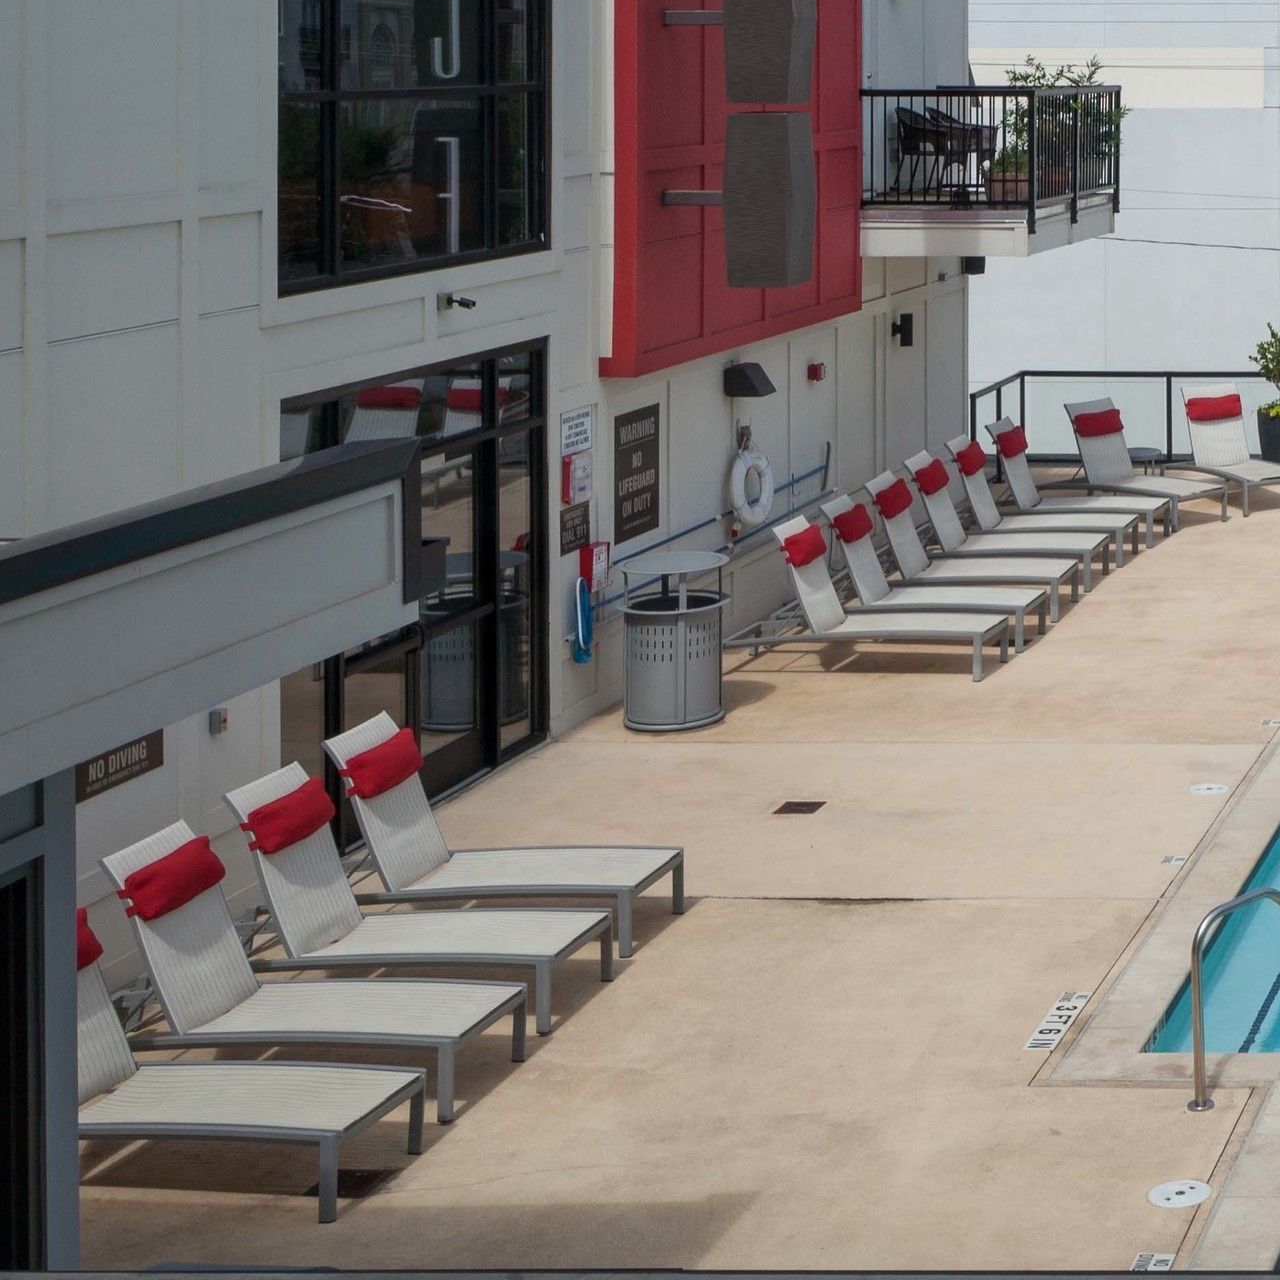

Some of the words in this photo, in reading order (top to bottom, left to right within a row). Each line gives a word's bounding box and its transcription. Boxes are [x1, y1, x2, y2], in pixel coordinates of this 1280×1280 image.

[619, 418, 655, 445] WARNING
[632, 451, 642, 469] NO
[618, 468, 655, 497] LIFEGUARD
[622, 500, 632, 518] ON
[633, 493, 652, 513] DUTY
[577, 524, 587, 539] 911
[88, 758, 105, 783] NO
[108, 741, 147, 774] DIVING
[1046, 1014, 1073, 1025] FT
[1027, 1038, 1056, 1048] IN
